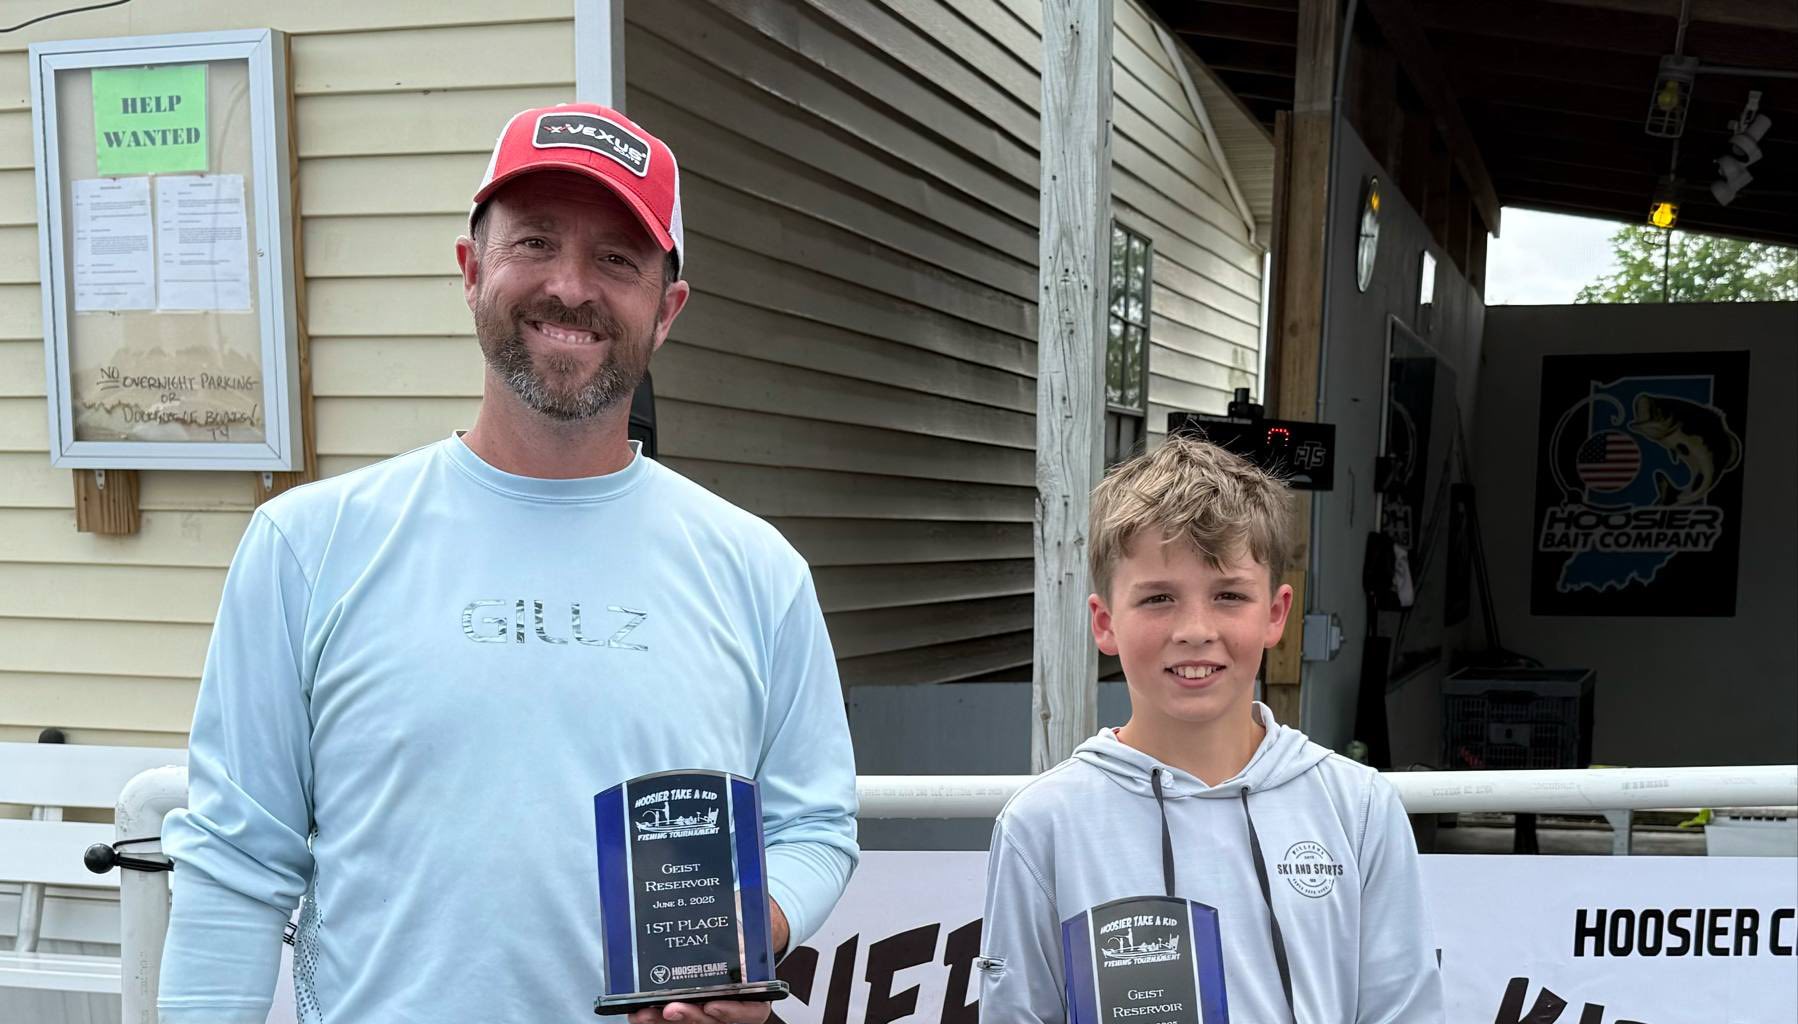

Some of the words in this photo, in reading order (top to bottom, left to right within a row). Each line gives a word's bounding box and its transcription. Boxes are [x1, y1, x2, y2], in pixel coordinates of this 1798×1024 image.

[121, 94, 182, 114] HELP
[104, 127, 201, 148] WANTED
[565, 124, 643, 161] VEXUS
[100, 366, 119, 380] NO
[123, 375, 195, 390] OVERNIGHT
[200, 372, 258, 391] PARKING
[161, 393, 180, 403] OR
[1549, 510, 1722, 529] HOOSIER
[1543, 532, 1597, 548] BAIT
[1601, 532, 1718, 548] COMPANY
[462, 599, 648, 651] GILLZ
[634, 790, 669, 808] HOOSIER
[671, 788, 692, 800] TAKE
[694, 789, 700, 799] A
[701, 791, 717, 800] KID
[637, 832, 667, 841] FISHING
[1277, 864, 1292, 874] SKI
[1295, 864, 1311, 874] AND
[690, 896, 715, 905] 2025
[646, 922, 673, 935] 1ST
[678, 916, 728, 932] PLACE
[1100, 917, 1132, 934] HOOSIER
[1133, 915, 1154, 928] TAKE
[1155, 916, 1162, 926] A
[1163, 917, 1178, 927] KID
[1574, 909, 1759, 957] HOOSIER
[1769, 909, 1798, 957] C
[665, 934, 709, 948] TEAM
[672, 965, 703, 976] HOOSIER
